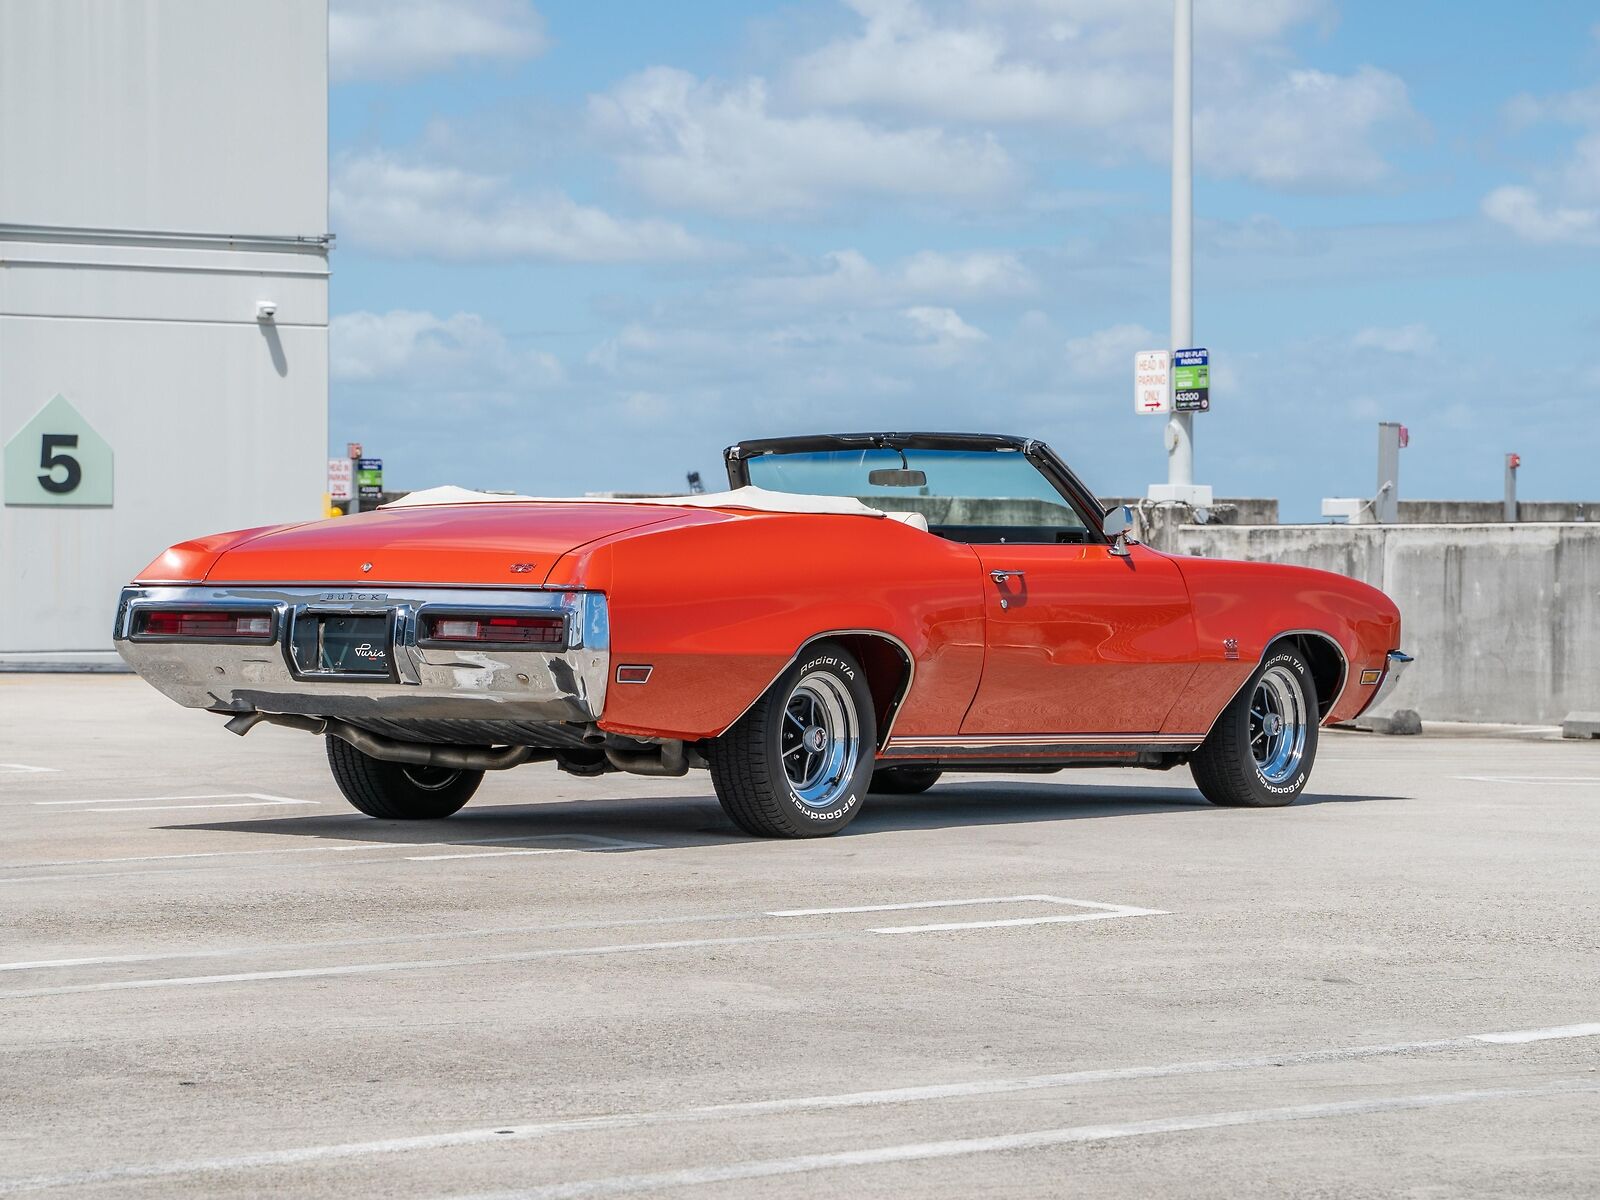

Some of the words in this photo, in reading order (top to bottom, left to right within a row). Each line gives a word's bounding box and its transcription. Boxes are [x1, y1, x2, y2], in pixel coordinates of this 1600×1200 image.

[1139, 359, 1155, 370] HEAD
[1159, 359, 1166, 370] IN
[1138, 374, 1166, 385] PARKING
[1144, 390, 1160, 401] ONLY
[1176, 392, 1199, 401] 43200
[37, 434, 82, 496] 5
[326, 593, 380, 601] BUICK
[800, 656, 838, 676] Radial
[840, 661, 855, 680] T/A
[1264, 654, 1292, 670] Radial
[1292, 658, 1305, 675] T/A
[1255, 769, 1305, 794] BFGoodrich
[789, 791, 857, 820] BFGoodrich
